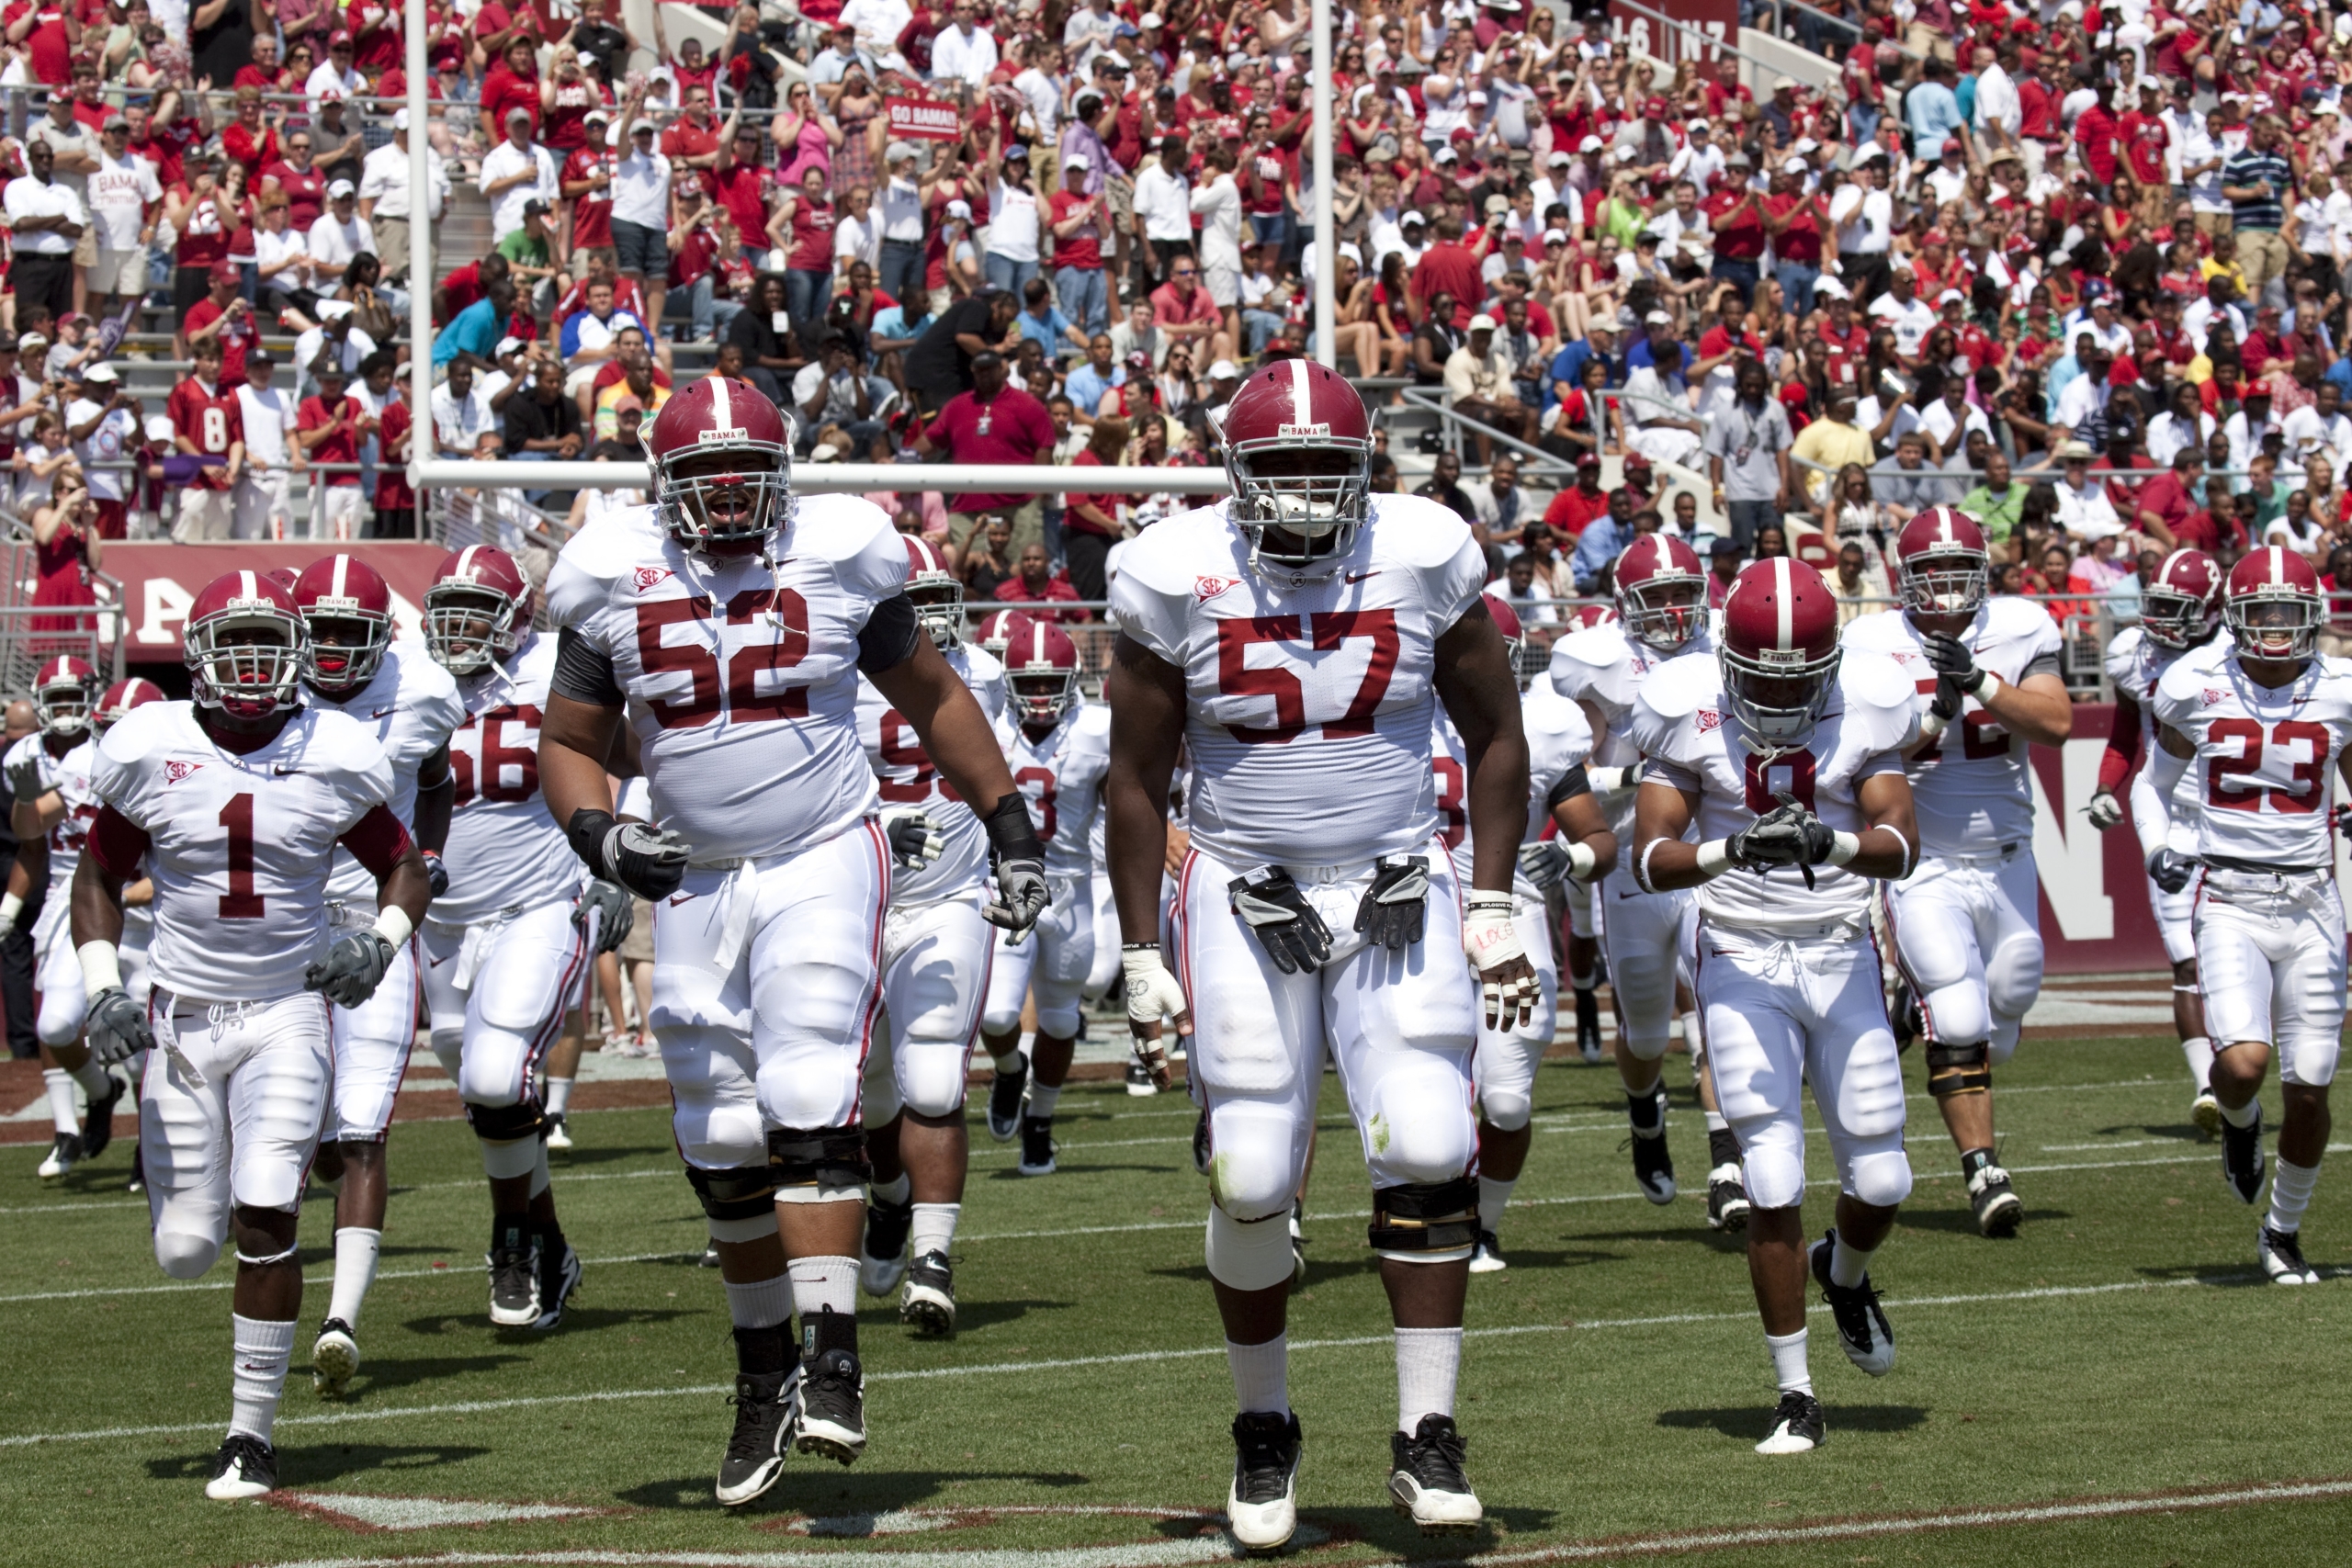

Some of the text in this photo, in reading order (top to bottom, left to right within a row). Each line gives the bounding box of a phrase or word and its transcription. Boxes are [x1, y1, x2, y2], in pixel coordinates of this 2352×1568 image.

[1680, 20, 1725, 62] N-7
[891, 105, 911, 123] GO
[98, 175, 141, 192] BAMA
[188, 200, 220, 234] 12
[204, 407, 227, 452] 8
[710, 432, 736, 440] BAMA
[1291, 427, 1318, 435] BAMA
[640, 570, 659, 585] SEC
[1203, 579, 1222, 596] SEC
[637, 587, 809, 729] 52
[1216, 608, 1400, 744] 57
[1702, 711, 1720, 728] SEC
[170, 762, 187, 778] SEC
[2208, 717, 2330, 814] 23
[219, 792, 266, 919] 1
